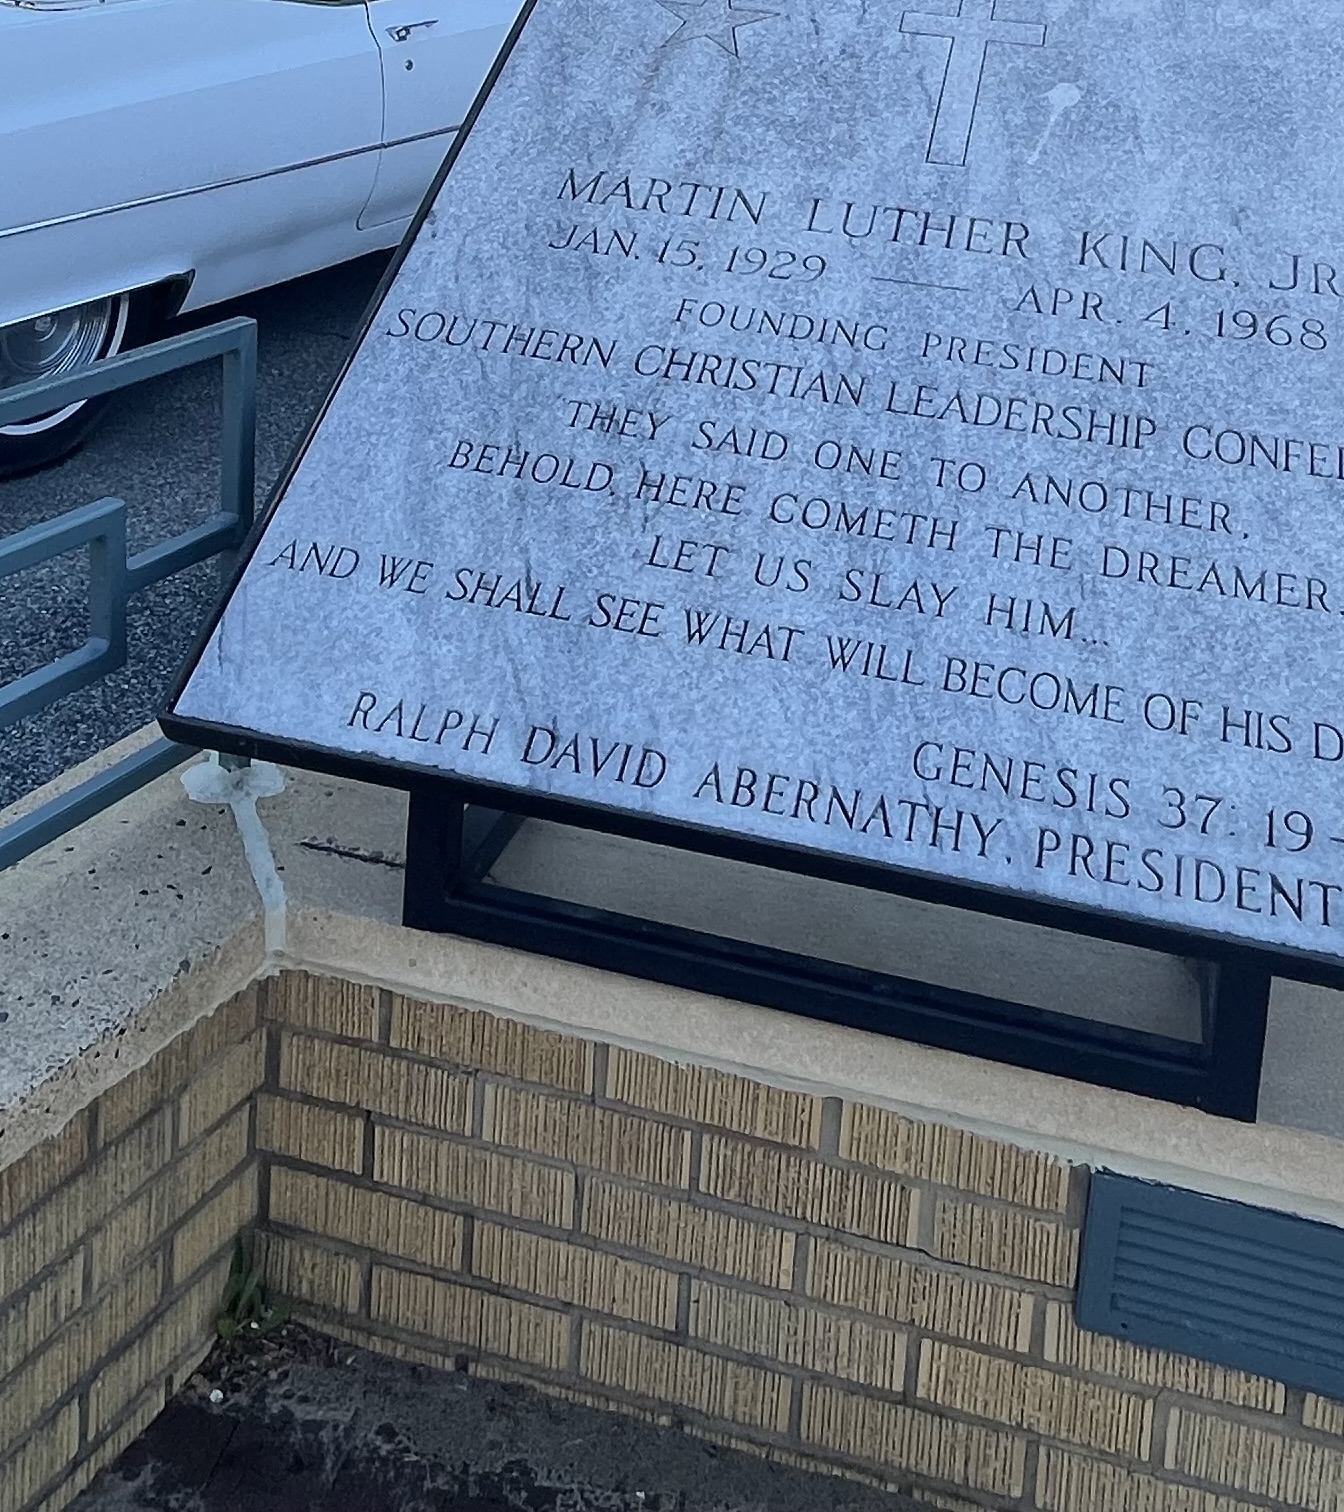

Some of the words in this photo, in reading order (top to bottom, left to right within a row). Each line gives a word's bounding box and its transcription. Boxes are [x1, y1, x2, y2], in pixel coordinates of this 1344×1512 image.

[557, 168, 766, 224] MARTIN
[804, 198, 1031, 259] LUTHER
[548, 224, 640, 261] JAN.
[725, 245, 828, 282] 1929
[1013, 284, 1123, 324] APR.
[1216, 309, 1328, 351] 1968
[386, 309, 618, 369] SOUTHERN
[634, 344, 866, 406] CHRISTIAN
[886, 381, 1156, 450] LEADERSHIP
[675, 298, 888, 351] FOUNDING
[922, 331, 1155, 389] PRESIDENT
[692, 420, 789, 462] SAID
[814, 440, 902, 481] ONE
[931, 456, 987, 493] TO
[636, 469, 747, 516] HERE
[770, 493, 958, 552] COMETH
[985, 526, 1074, 571] THE
[645, 535, 732, 578] LET
[754, 553, 813, 593] US
[838, 568, 959, 618] SLAY
[986, 593, 1110, 648] HIM...
[269, 539, 361, 581] AND
[378, 553, 435, 594] WE
[445, 568, 573, 622] SHALL
[588, 593, 666, 638] SEE
[684, 608, 805, 662] WHAT
[826, 634, 925, 686] WILL
[943, 656, 1126, 724] BECOME
[1144, 693, 1204, 736] OF
[1220, 706, 1292, 754] HIS
[347, 692, 501, 756] RALPH
[520, 725, 667, 788] DAVID
[1034, 826, 1344, 927] PRESIDENT
[912, 741, 1132, 820] GENESIS
[1157, 785, 1237, 837] 37:
